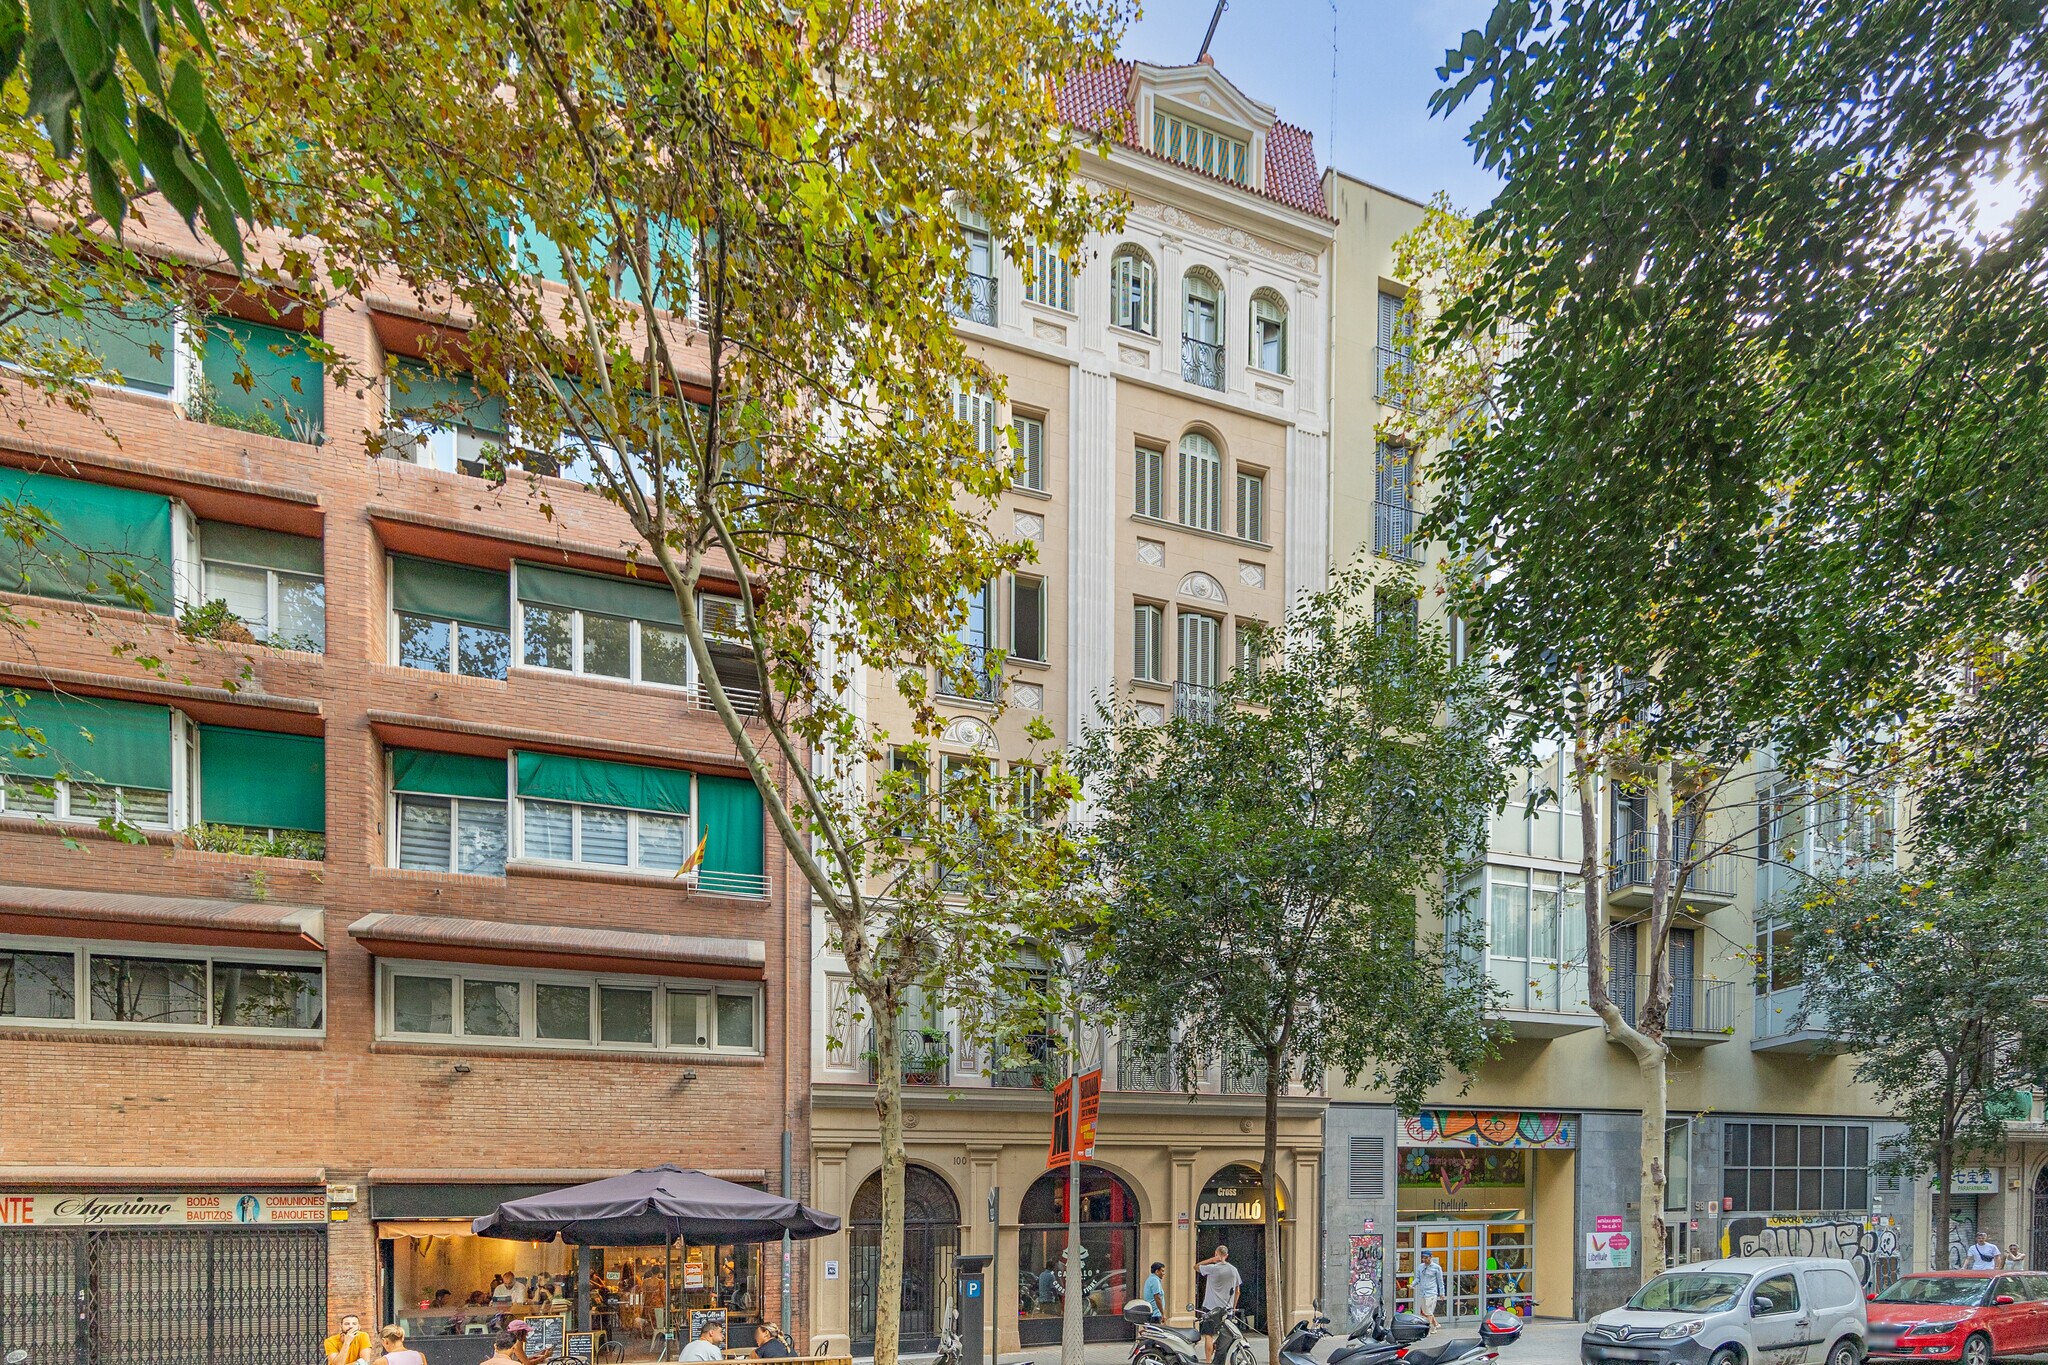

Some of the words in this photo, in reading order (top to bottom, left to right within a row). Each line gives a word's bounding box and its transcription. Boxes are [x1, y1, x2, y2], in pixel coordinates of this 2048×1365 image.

[953, 1157, 967, 1165] 100
[1217, 1187, 1237, 1197] Cross
[187, 1197, 220, 1206] BODAS
[265, 1197, 325, 1206] COMUNIONES
[1433, 1198, 1468, 1212] Libellule
[1695, 1201, 1704, 1211] 98
[0, 1197, 34, 1223] NTE
[53, 1197, 172, 1223] Agarimo
[271, 1210, 325, 1219] BANQUETES
[1200, 1199, 1262, 1220] CATHALÓ
[187, 1211, 233, 1220] BAUTIZOS
[1057, 1270, 1093, 1278] CALO
[969, 1282, 978, 1296] P
[1083, 1279, 1098, 1294] FIGHT
